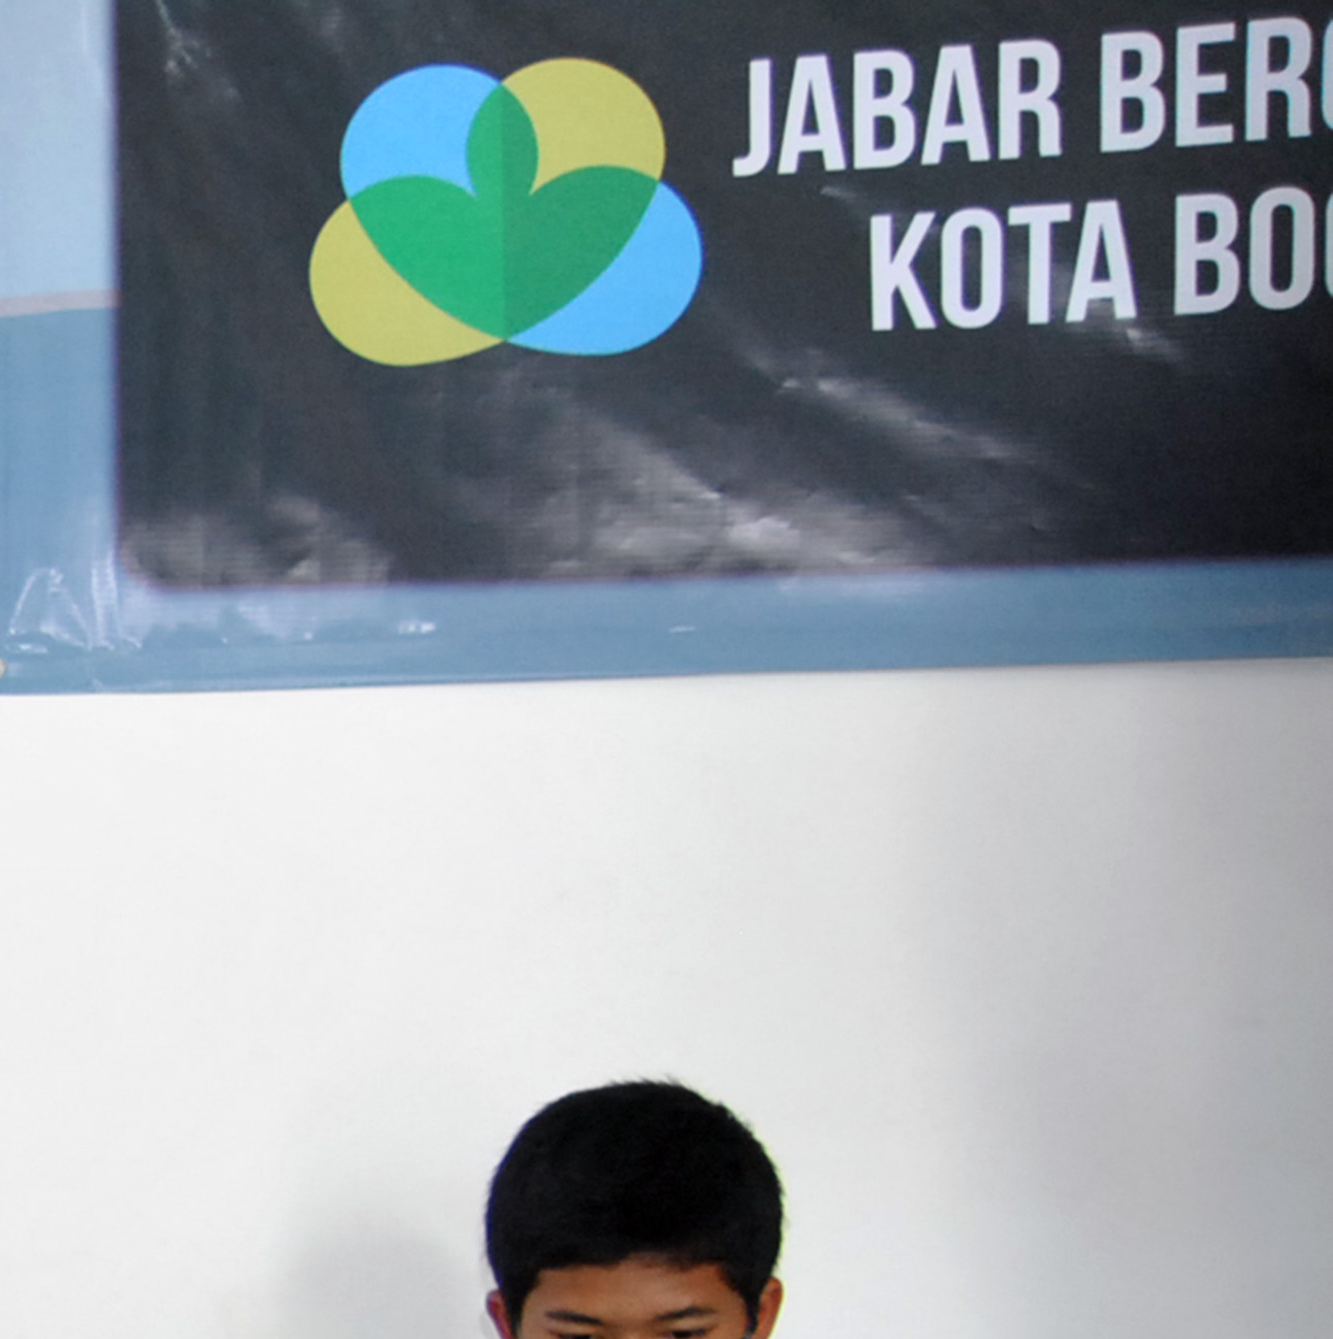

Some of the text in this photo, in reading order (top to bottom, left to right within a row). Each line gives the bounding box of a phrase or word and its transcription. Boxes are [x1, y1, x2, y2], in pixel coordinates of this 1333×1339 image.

[732, 15, 1333, 177] JABAR BER
[869, 186, 1333, 332] KOTA BO
